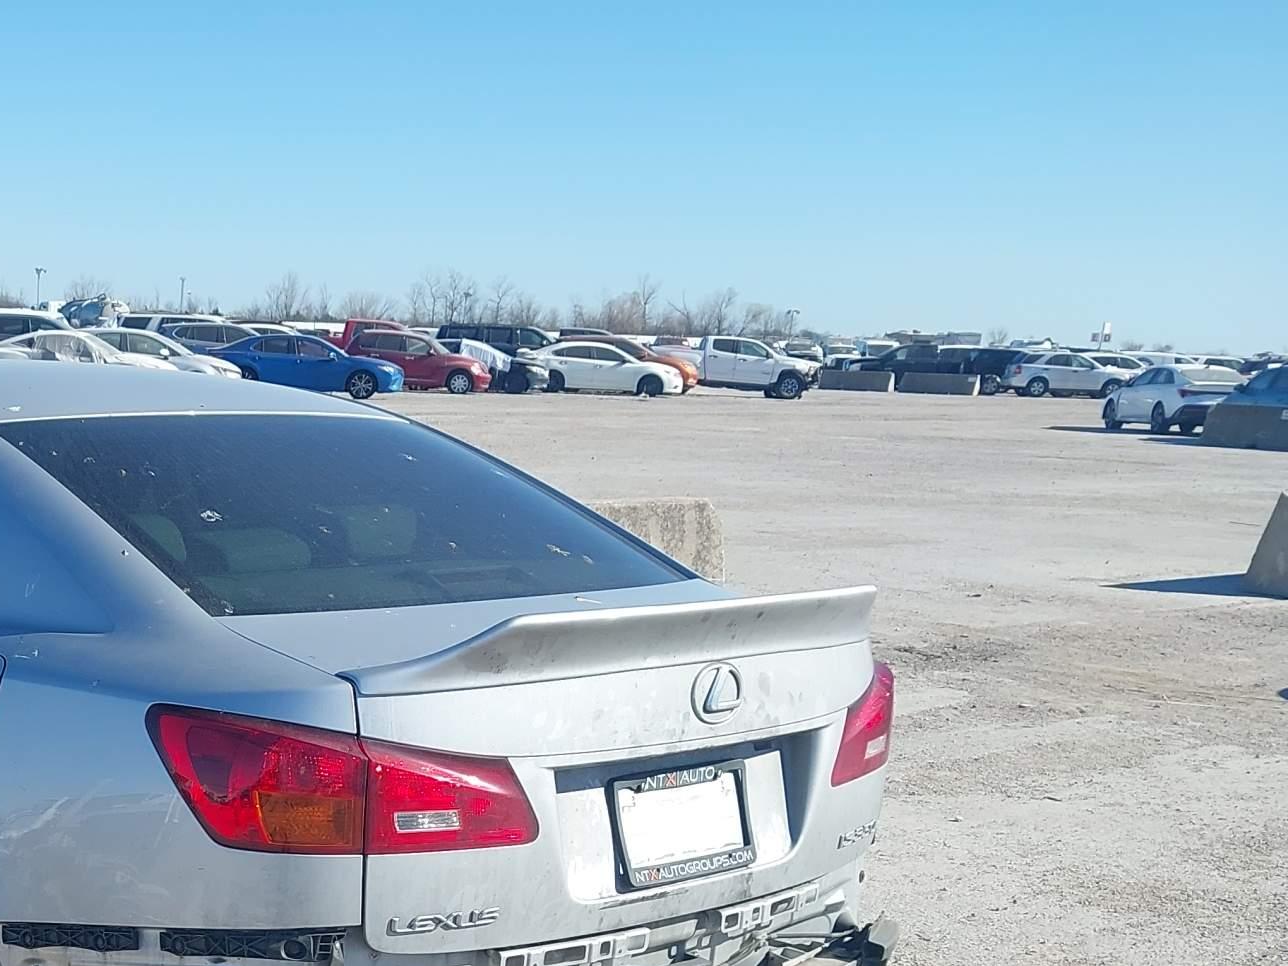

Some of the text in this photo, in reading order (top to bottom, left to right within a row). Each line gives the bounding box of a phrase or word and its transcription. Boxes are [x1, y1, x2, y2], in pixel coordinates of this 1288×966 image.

[645, 766, 715, 790] NTX AUTO
[386, 906, 501, 936] LEXUS
